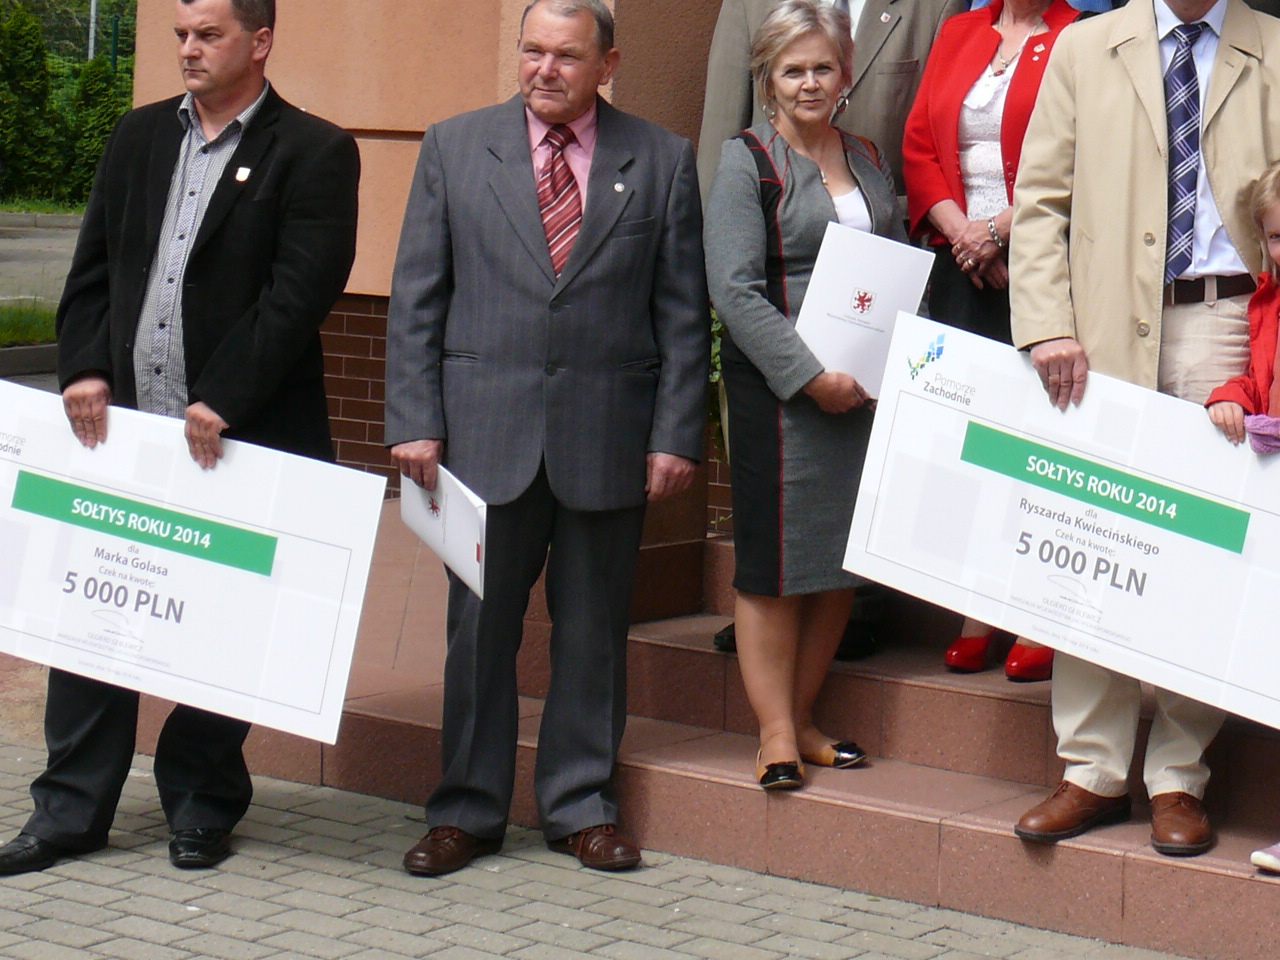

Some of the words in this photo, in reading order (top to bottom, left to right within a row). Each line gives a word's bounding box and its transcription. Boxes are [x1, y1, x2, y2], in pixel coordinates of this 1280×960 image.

[924, 381, 971, 406] Zachodnie
[935, 373, 976, 396] Pomorze
[1026, 455, 1085, 488] SOŁTYS
[1087, 476, 1134, 504] ROKU
[1136, 493, 1177, 518] 2014
[72, 498, 126, 526] SOŁTYS
[128, 514, 172, 538] ROKU
[172, 525, 212, 548] 2014
[1020, 498, 1072, 526] Ryszarda
[1074, 516, 1160, 555] Kwiecińskiego
[1085, 509, 1098, 519] dla
[128, 545, 139, 554] dla
[1055, 529, 1074, 542] Czek
[1076, 537, 1086, 546] na
[94, 547, 128, 566] Marka
[131, 557, 168, 576] Golasa
[99, 566, 116, 577] Czek
[118, 572, 128, 580] na
[1016, 531, 1032, 555] 5
[1038, 540, 1087, 574] 000
[1092, 557, 1147, 596] PLN
[62, 571, 78, 594] 5
[84, 577, 128, 608] 000
[134, 590, 184, 624] PLN
